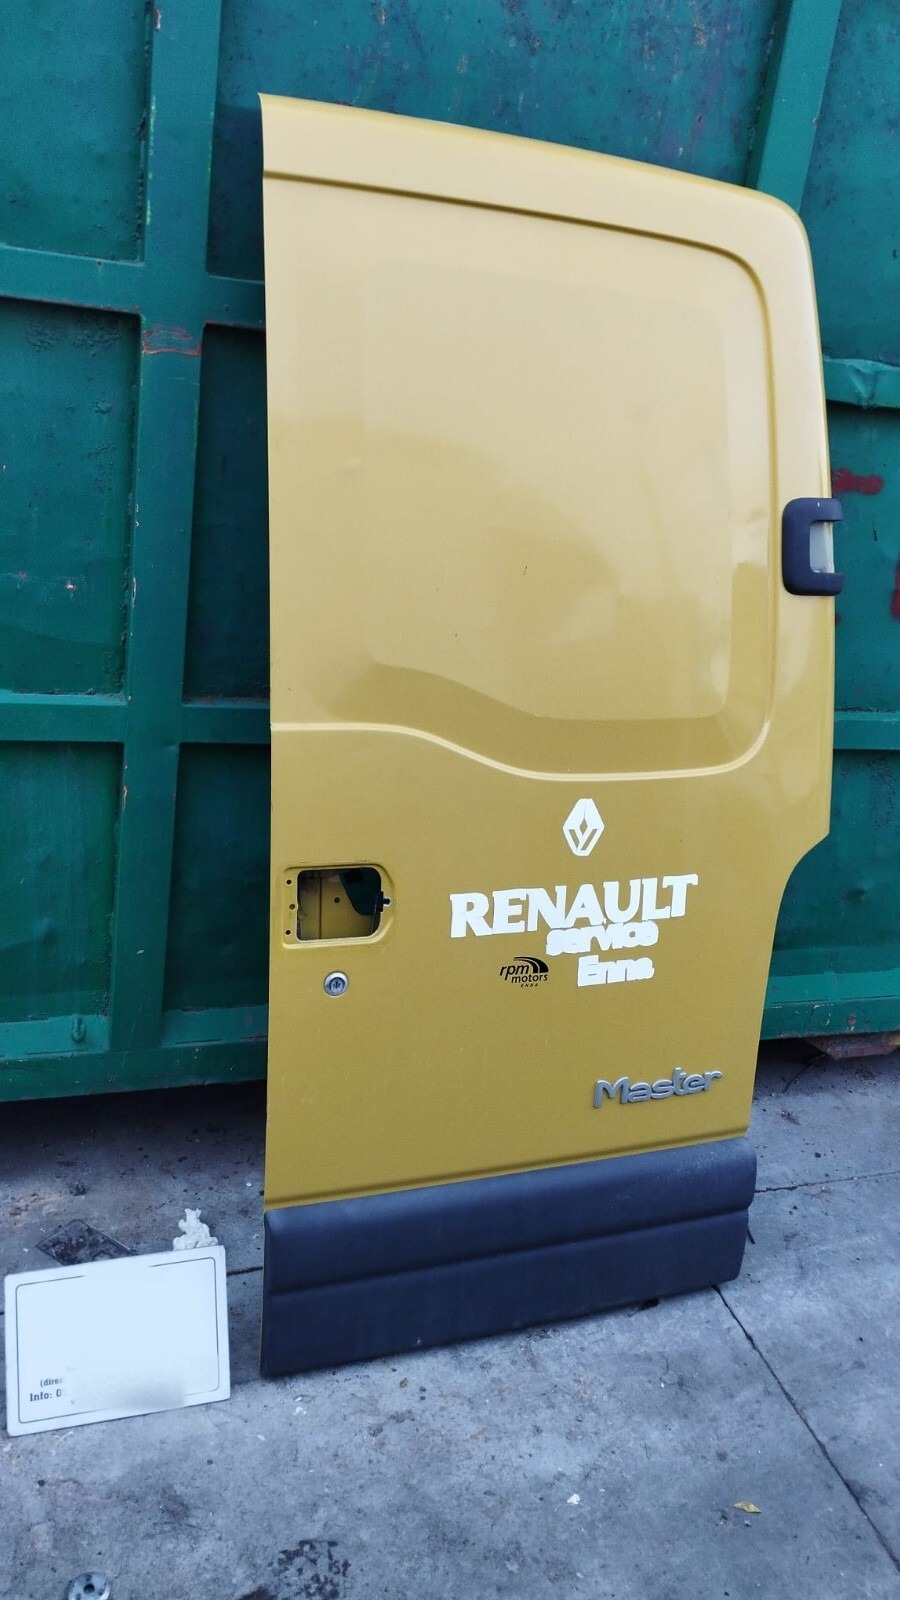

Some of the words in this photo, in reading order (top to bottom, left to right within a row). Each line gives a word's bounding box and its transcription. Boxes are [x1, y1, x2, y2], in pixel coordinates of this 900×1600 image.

[450, 874, 698, 938] RENAULT
[499, 965, 530, 981] rpm
[511, 974, 548, 984] motors
[593, 1067, 723, 1109] Master
[29, 1391, 53, 1402] Info:
